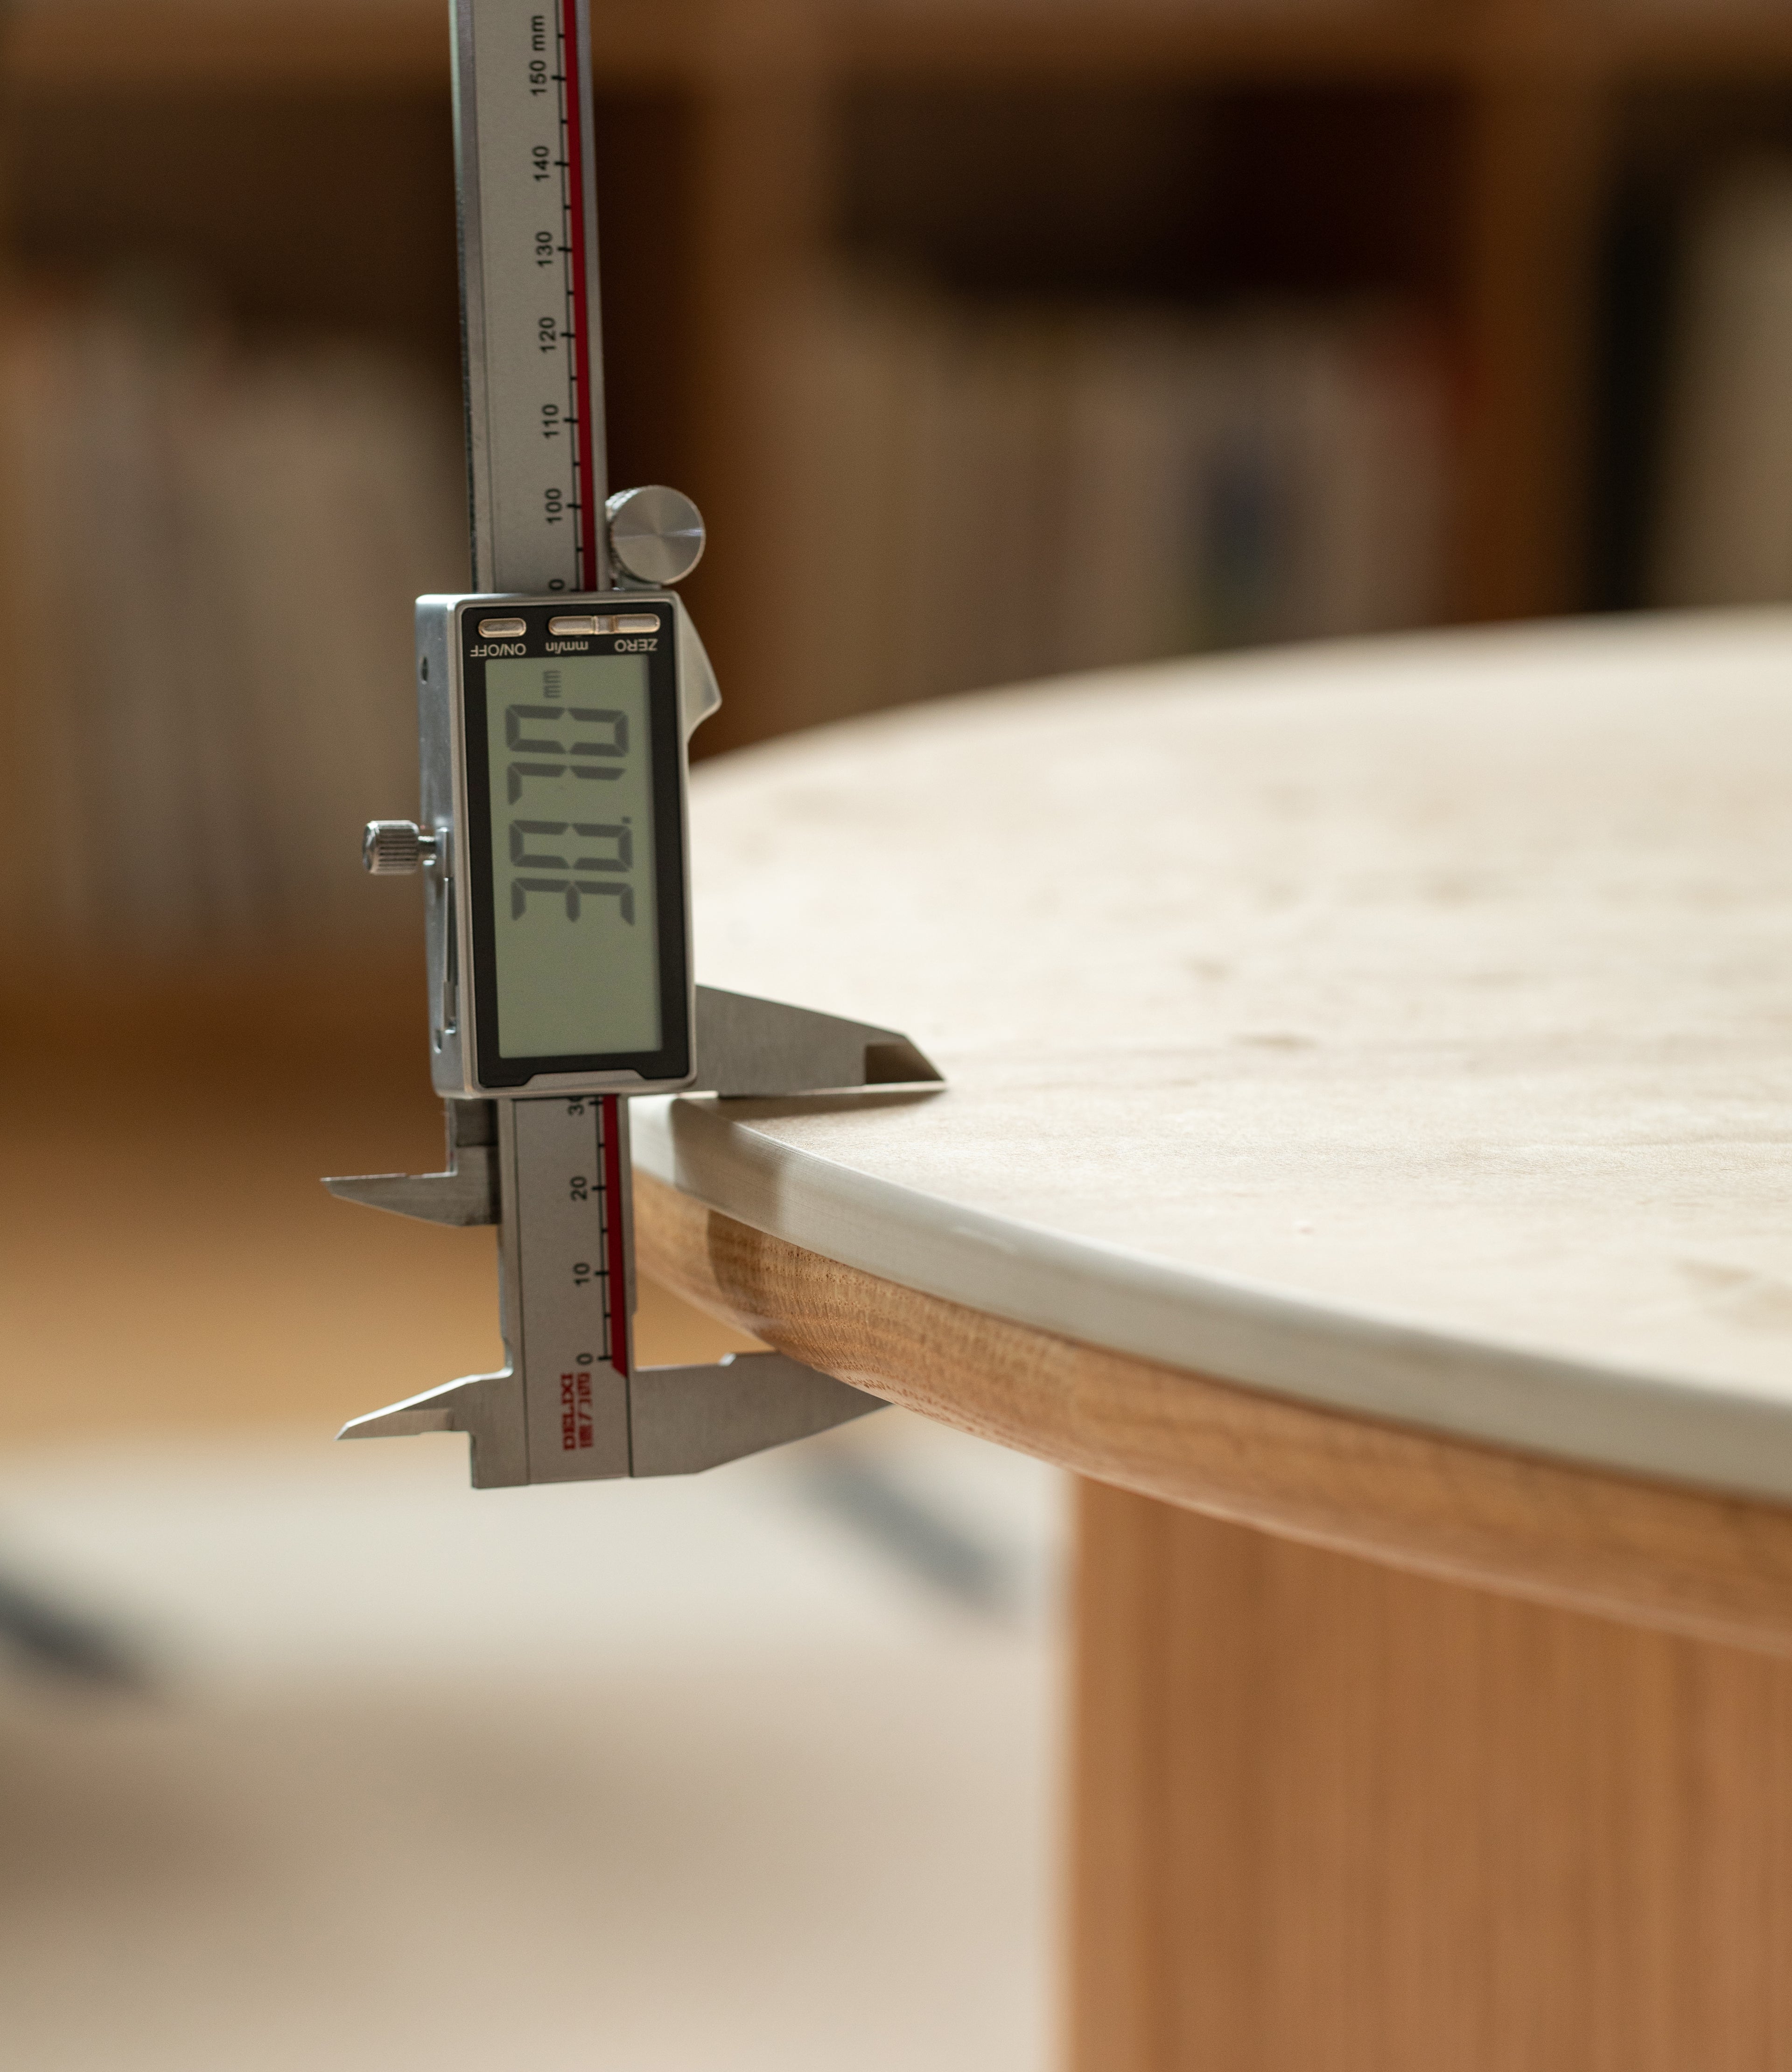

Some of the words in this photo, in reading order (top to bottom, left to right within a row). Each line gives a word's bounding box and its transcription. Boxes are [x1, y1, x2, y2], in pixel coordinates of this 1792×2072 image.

[532, 15, 545, 51] mm
[529, 60, 547, 96] 150
[532, 146, 550, 182] 140
[535, 231, 553, 267] 130
[538, 317, 556, 353] 120
[541, 404, 559, 439] 110
[545, 488, 562, 525] 100
[470, 643, 526, 657] ON/OFF
[545, 641, 589, 654] mm/in
[614, 638, 658, 652] ZERO
[542, 670, 561, 699] mm
[504, 704, 636, 926] 30.70
[570, 1176, 588, 1201] 20
[573, 1262, 590, 1286] 10
[576, 1352, 593, 1365] 0
[560, 1373, 576, 1450] DELIXI
